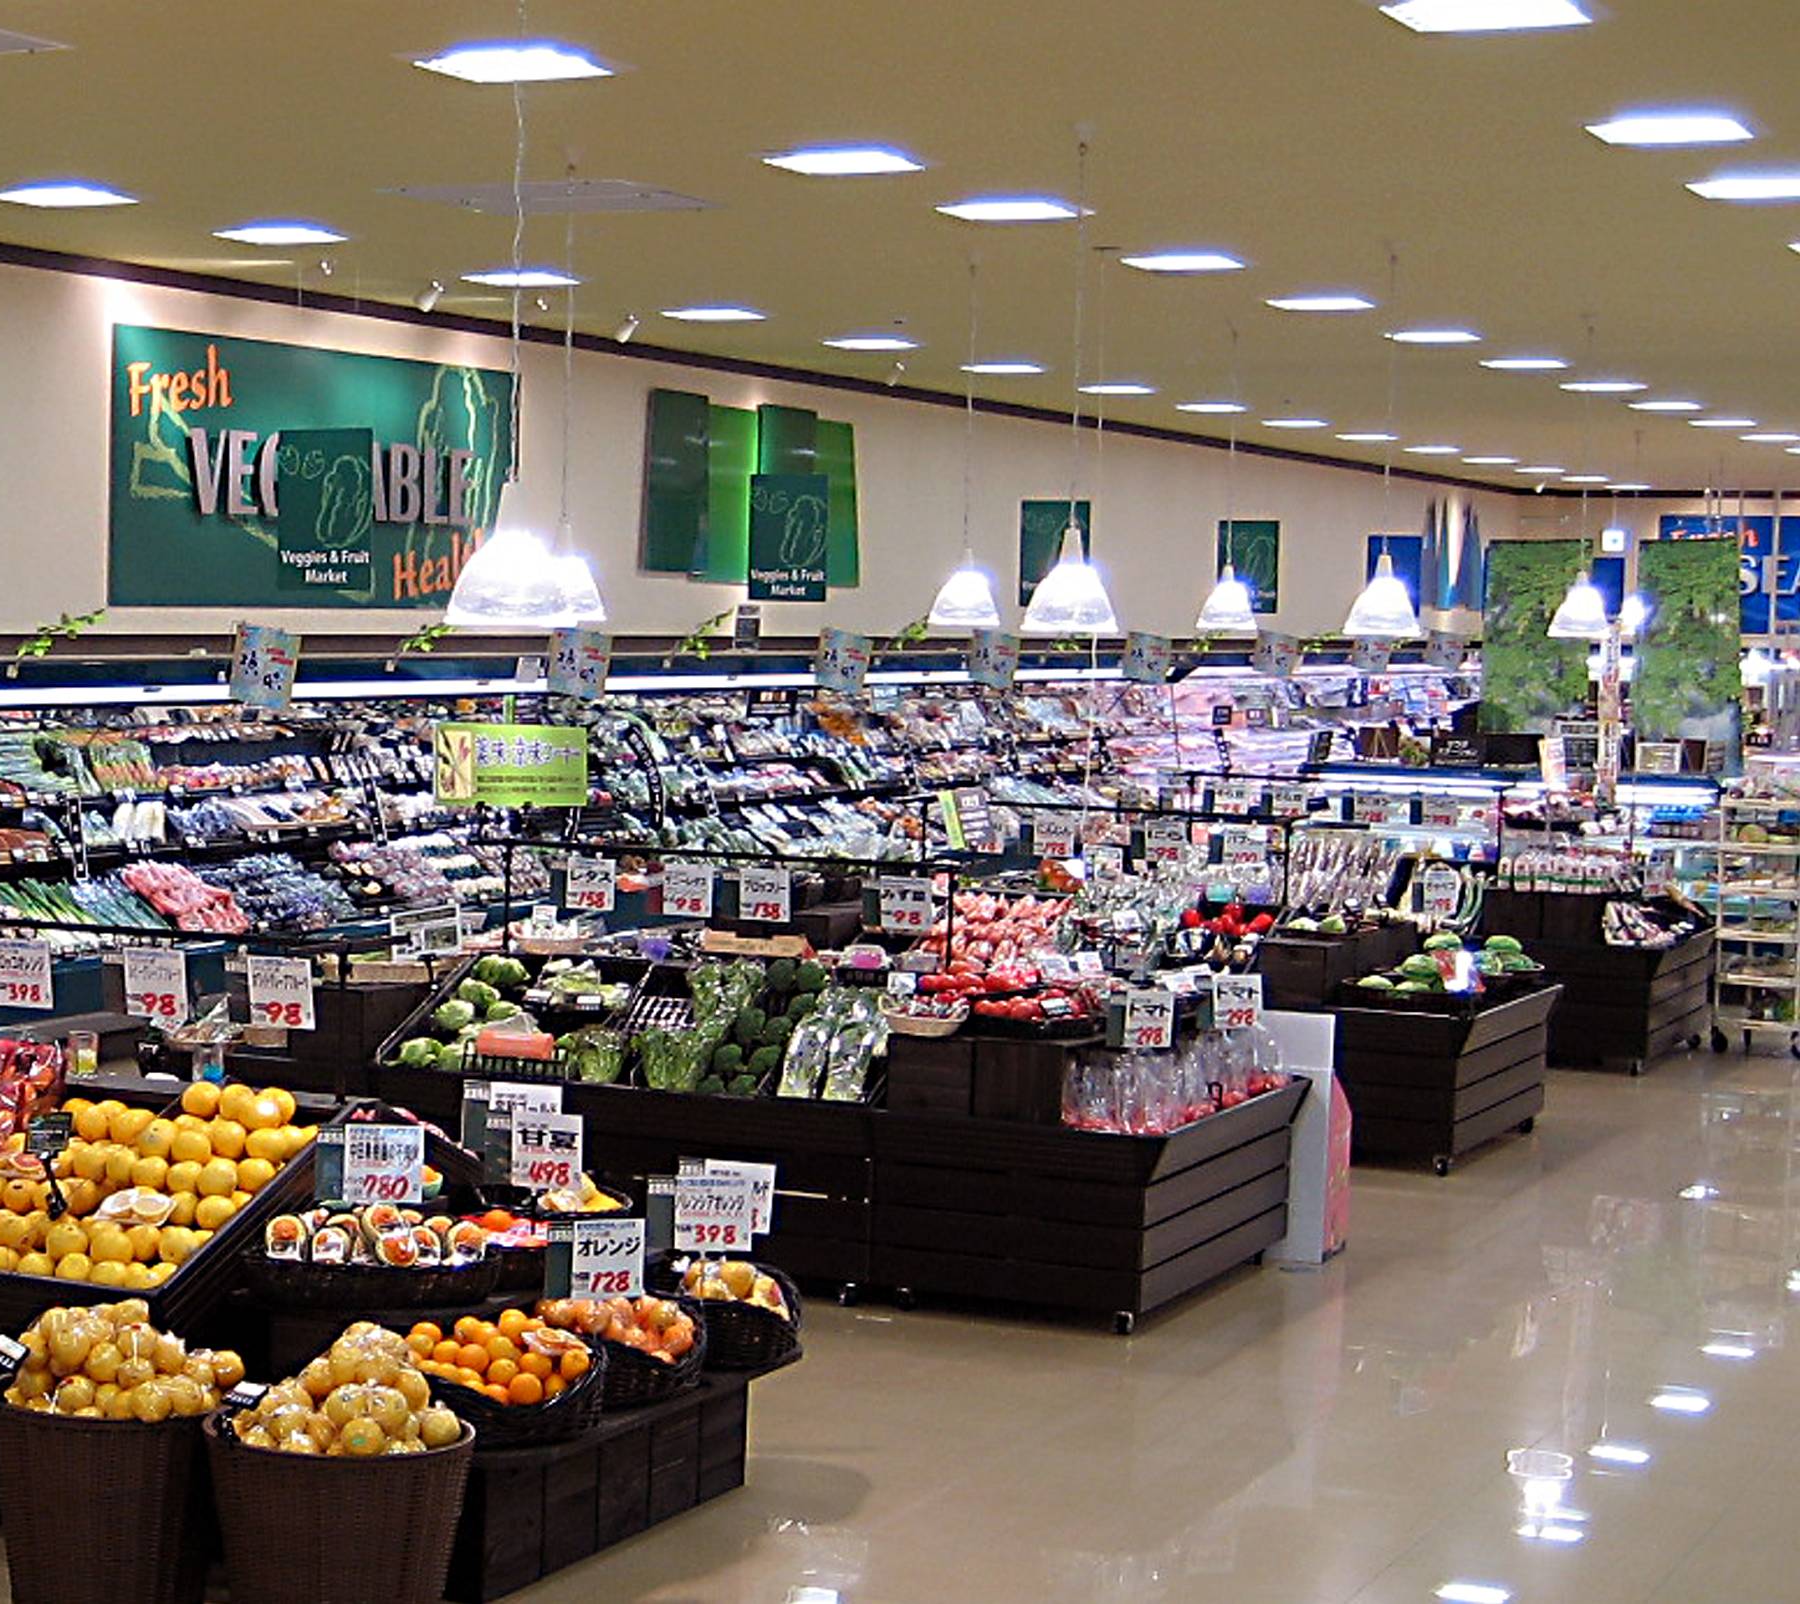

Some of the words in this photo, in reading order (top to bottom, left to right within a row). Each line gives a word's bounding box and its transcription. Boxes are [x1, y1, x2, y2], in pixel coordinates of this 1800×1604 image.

[125, 343, 234, 418] Fresh
[280, 549, 328, 568] Veggies
[329, 550, 340, 564] &
[341, 549, 370, 564] Fruit
[305, 569, 348, 584] Market
[751, 568, 790, 585] Veggies
[791, 568, 800, 581] &
[801, 568, 825, 581] Fruit
[770, 584, 807, 597] Market
[571, 871, 613, 884] レタス
[674, 898, 704, 913] 98
[893, 909, 922, 925] 98
[8, 983, 42, 1003] 398
[1218, 984, 1260, 1000] トマト
[142, 993, 177, 1017] 98
[265, 1002, 302, 1027] 98
[1130, 1002, 1171, 1018] トマト
[516, 1128, 580, 1151] 甘夏
[529, 1160, 572, 1187] 498
[362, 1174, 410, 1203] 780
[694, 1224, 737, 1245] 398
[577, 1236, 641, 1257] オレンジ
